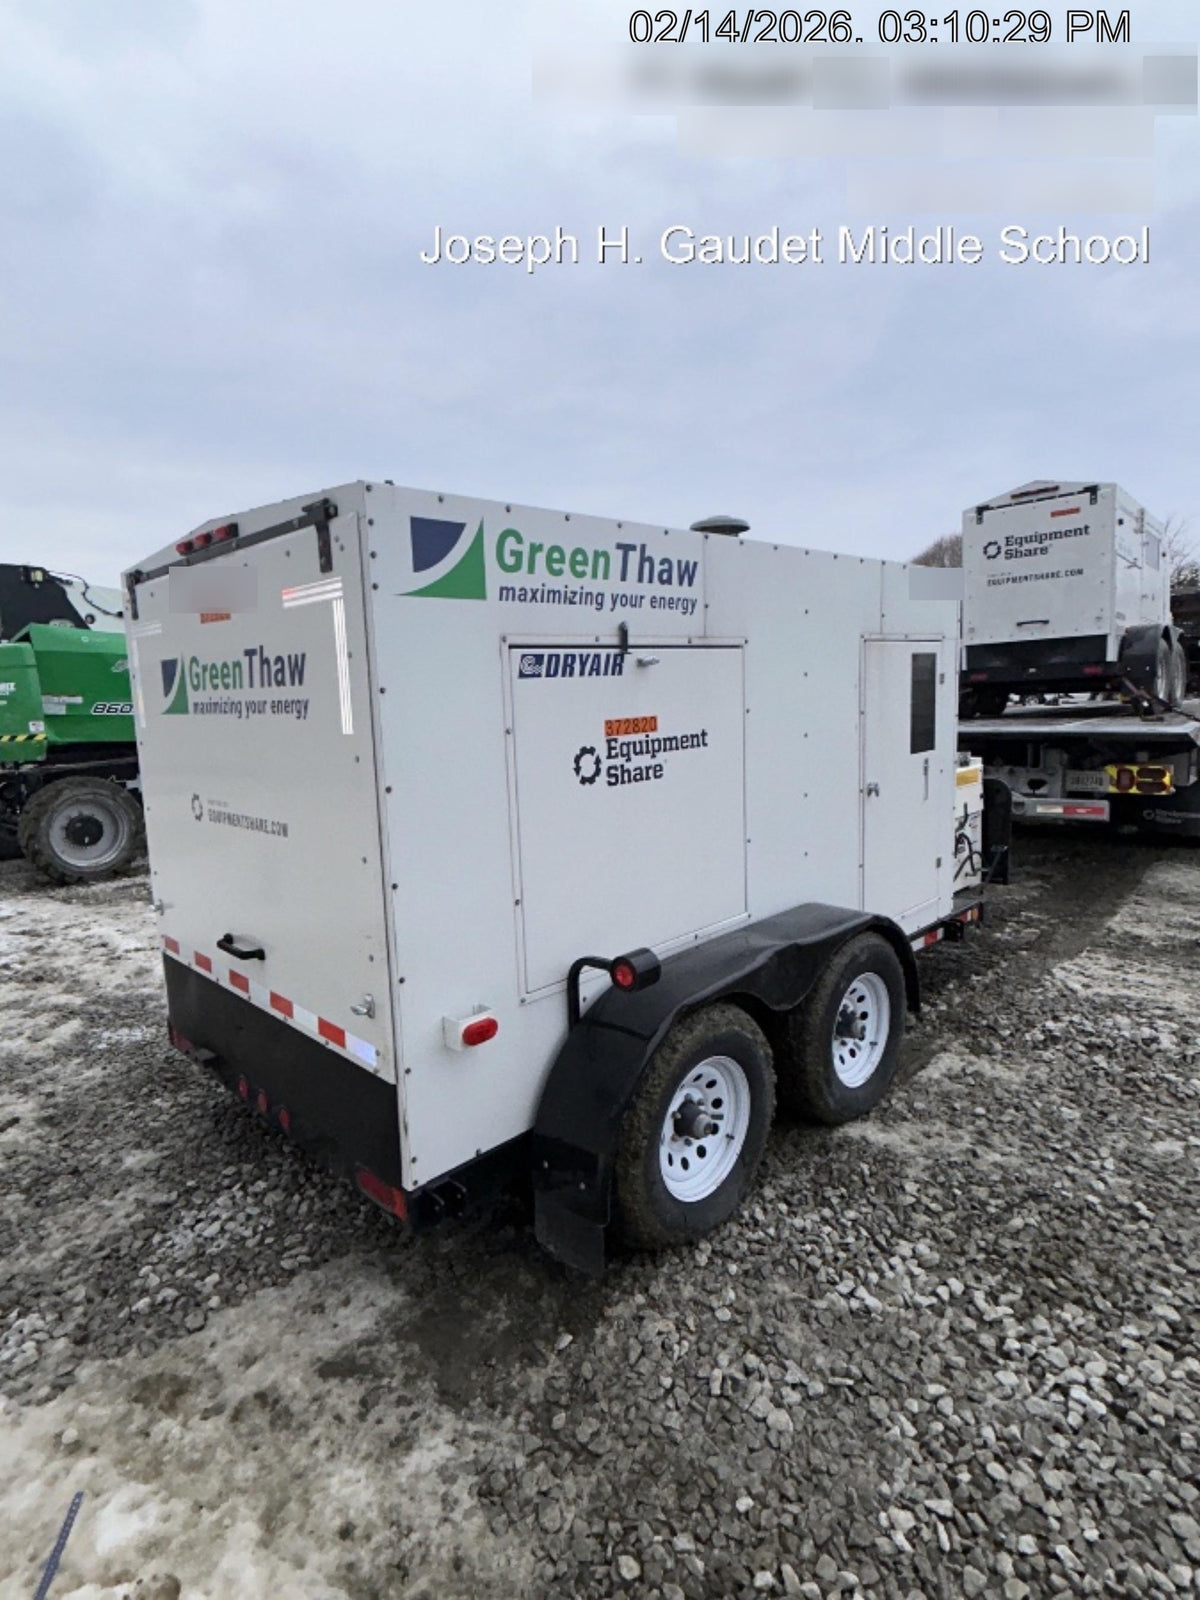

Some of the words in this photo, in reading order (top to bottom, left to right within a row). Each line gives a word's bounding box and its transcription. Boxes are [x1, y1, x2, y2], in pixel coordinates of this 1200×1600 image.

[1003, 524, 1091, 548] Equipment
[495, 528, 699, 588] GreenThaw
[1003, 545, 1049, 561] Share
[499, 583, 605, 611] maximizing
[610, 593, 645, 612] your
[650, 594, 698, 616] energy
[189, 645, 307, 693] GreenThaw
[544, 652, 626, 679] DRYAIR
[92, 702, 134, 714] 860
[192, 697, 243, 720] maximizing
[245, 699, 268, 720] your
[271, 698, 310, 721] energy
[604, 716, 657, 737] 372820
[605, 728, 708, 763] Equipment
[605, 763, 664, 787] Share
